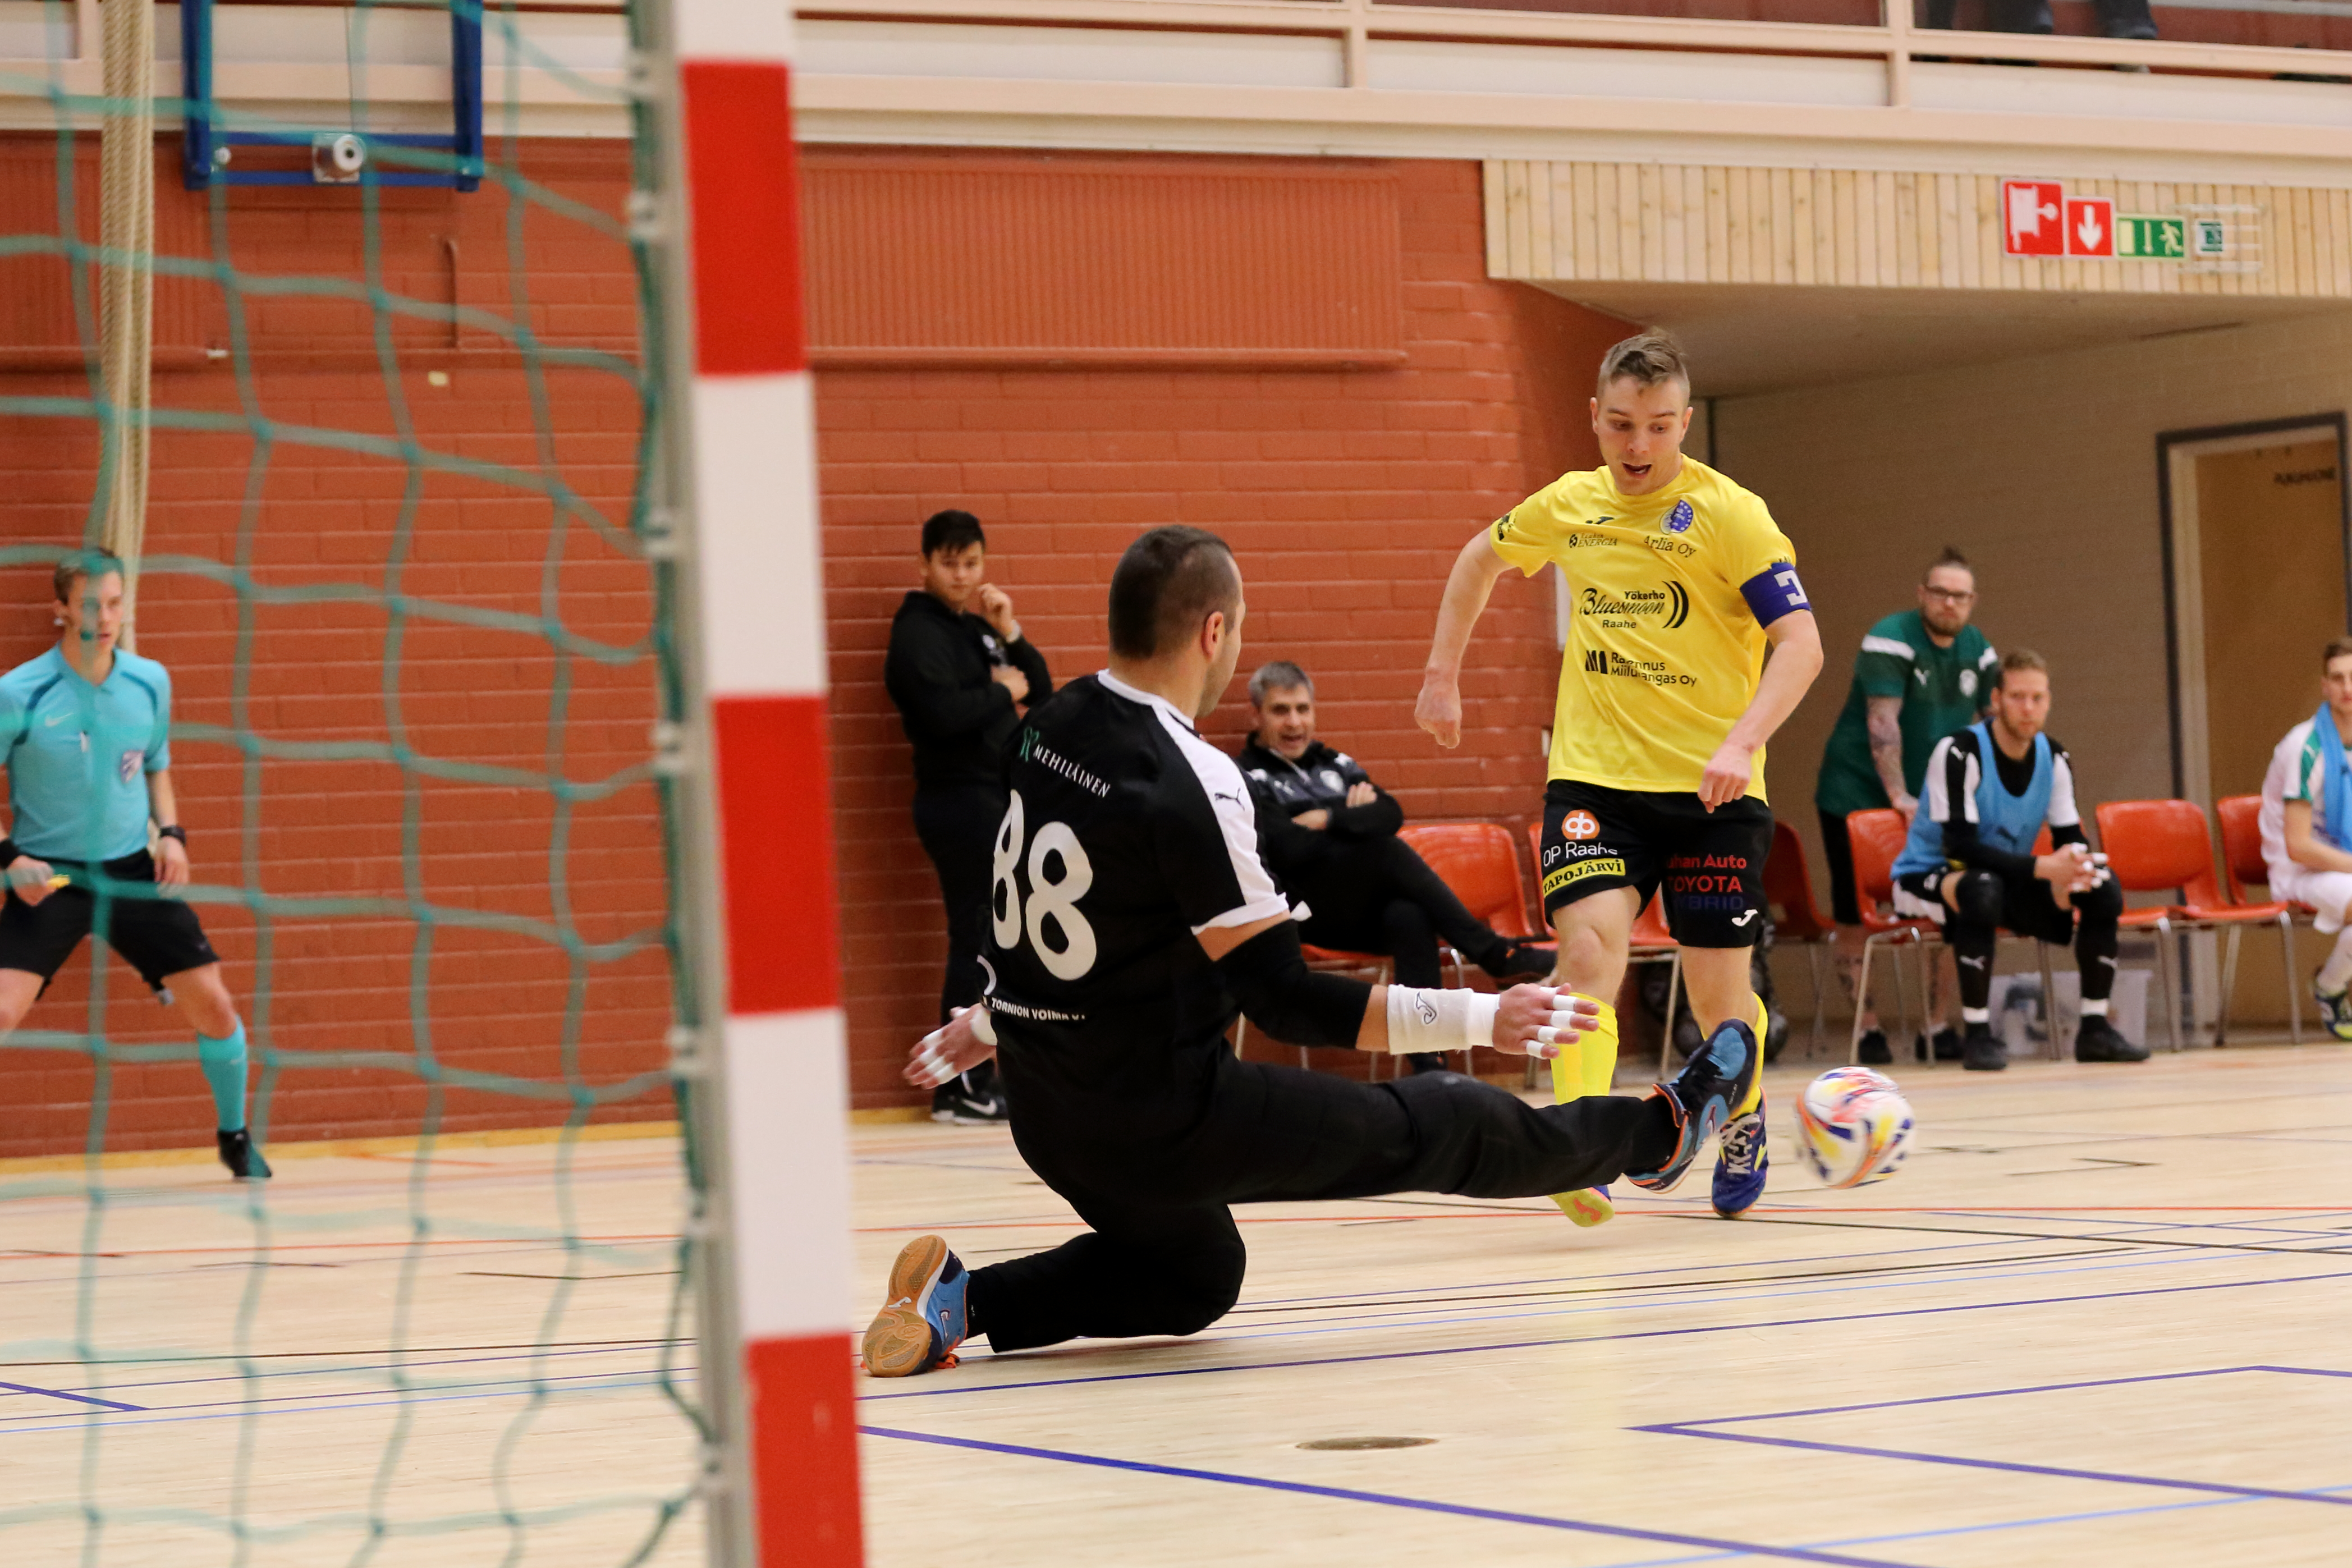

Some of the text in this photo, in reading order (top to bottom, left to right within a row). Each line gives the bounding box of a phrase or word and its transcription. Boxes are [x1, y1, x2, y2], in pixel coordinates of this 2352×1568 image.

[1577, 538, 1618, 548] ENERGIA
[1644, 535, 1697, 558] Arlia Oy
[1579, 587, 1665, 615] Bluesmoon
[1624, 590, 1666, 600] Yökerho
[1602, 619, 1637, 629] Raahe
[1680, 675, 1697, 687] Oy
[1543, 845, 1561, 867] OP
[1703, 852, 1748, 869] Auto
[992, 788, 1097, 981] 88
[1543, 859, 1622, 893] TAPOJÄRVI
[1667, 874, 1744, 893] TOYOTA
[991, 997, 1030, 1019] TORNION
